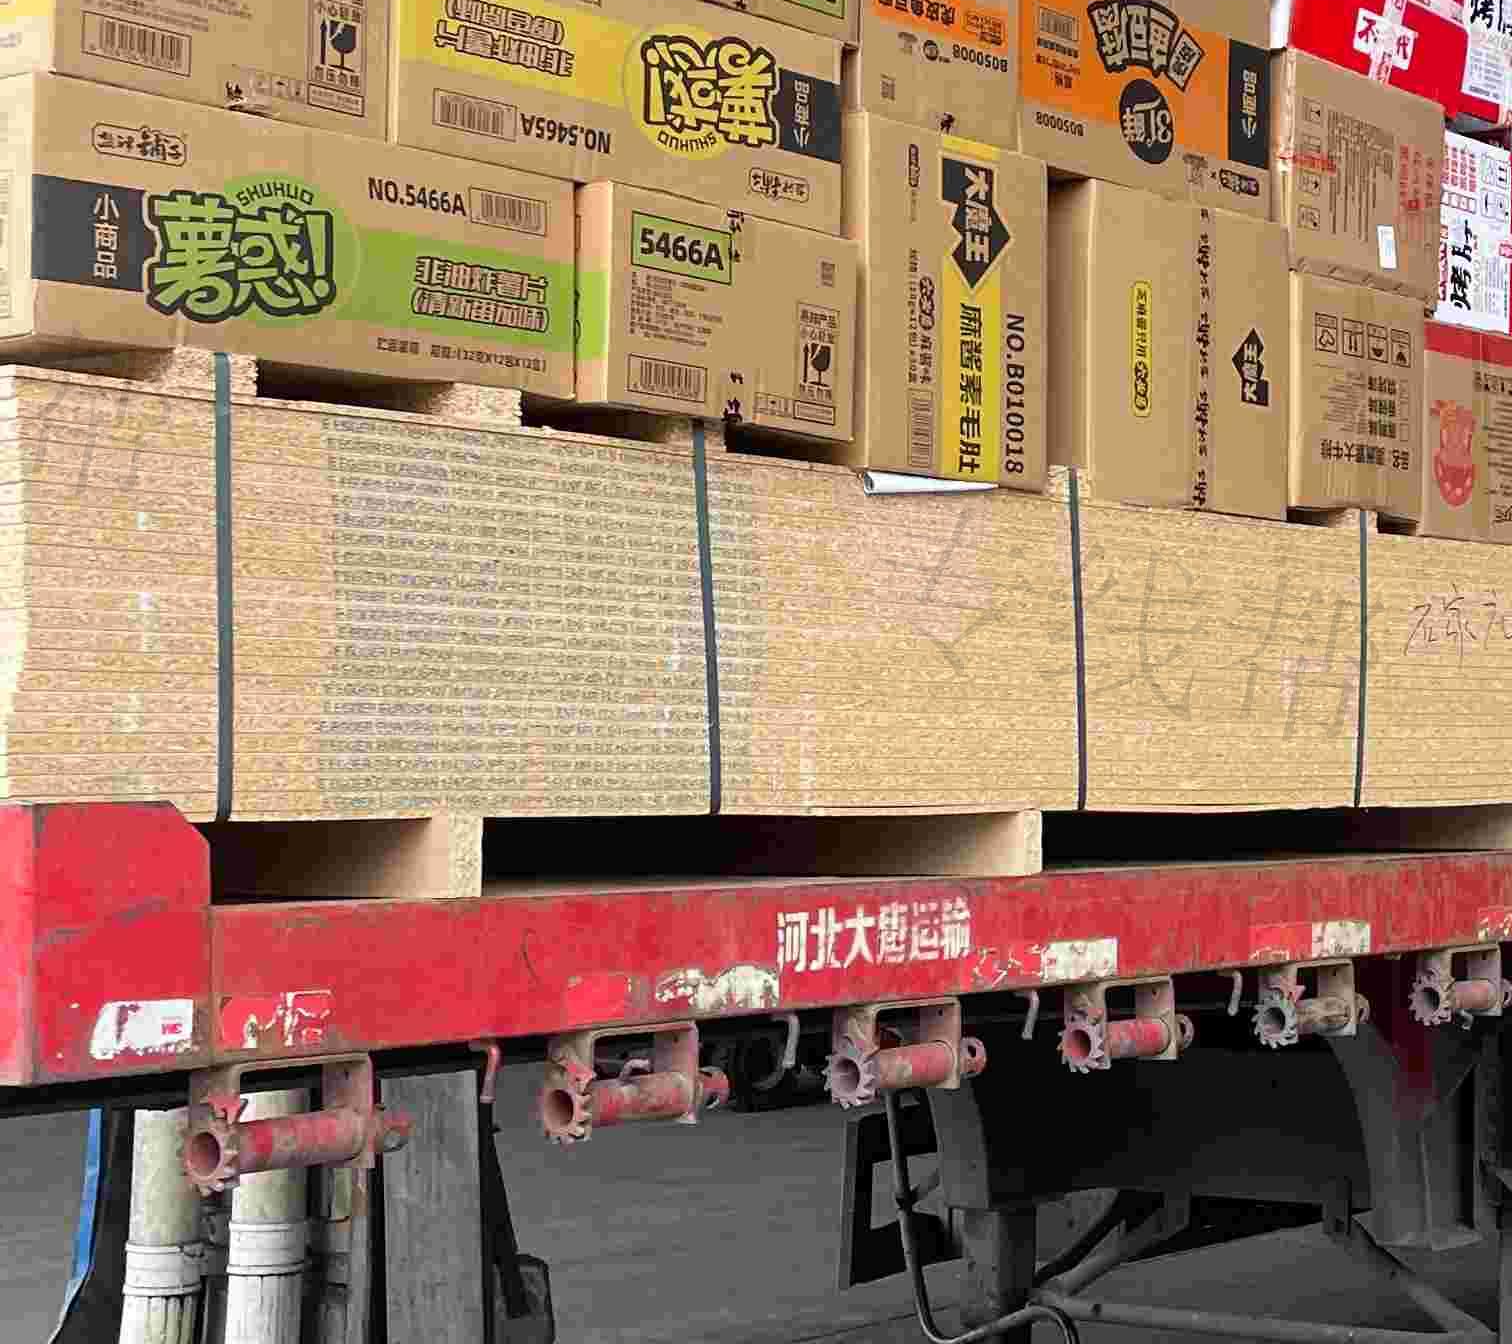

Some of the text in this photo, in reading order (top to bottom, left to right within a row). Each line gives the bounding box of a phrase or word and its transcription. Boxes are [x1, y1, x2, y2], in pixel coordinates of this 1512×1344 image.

[519, 112, 612, 155] NO.5465A
[656, 129, 717, 153] SHUHUO
[236, 179, 314, 206] SHUHUO
[367, 175, 468, 219] NO.5466A
[964, 166, 994, 265] 大魔王
[93, 192, 121, 281] 小商品
[147, 190, 336, 322] 薯惑!
[639, 227, 726, 273] 5466A
[415, 255, 549, 304] 非油炸薯片
[1004, 312, 1025, 475] NO.B010018
